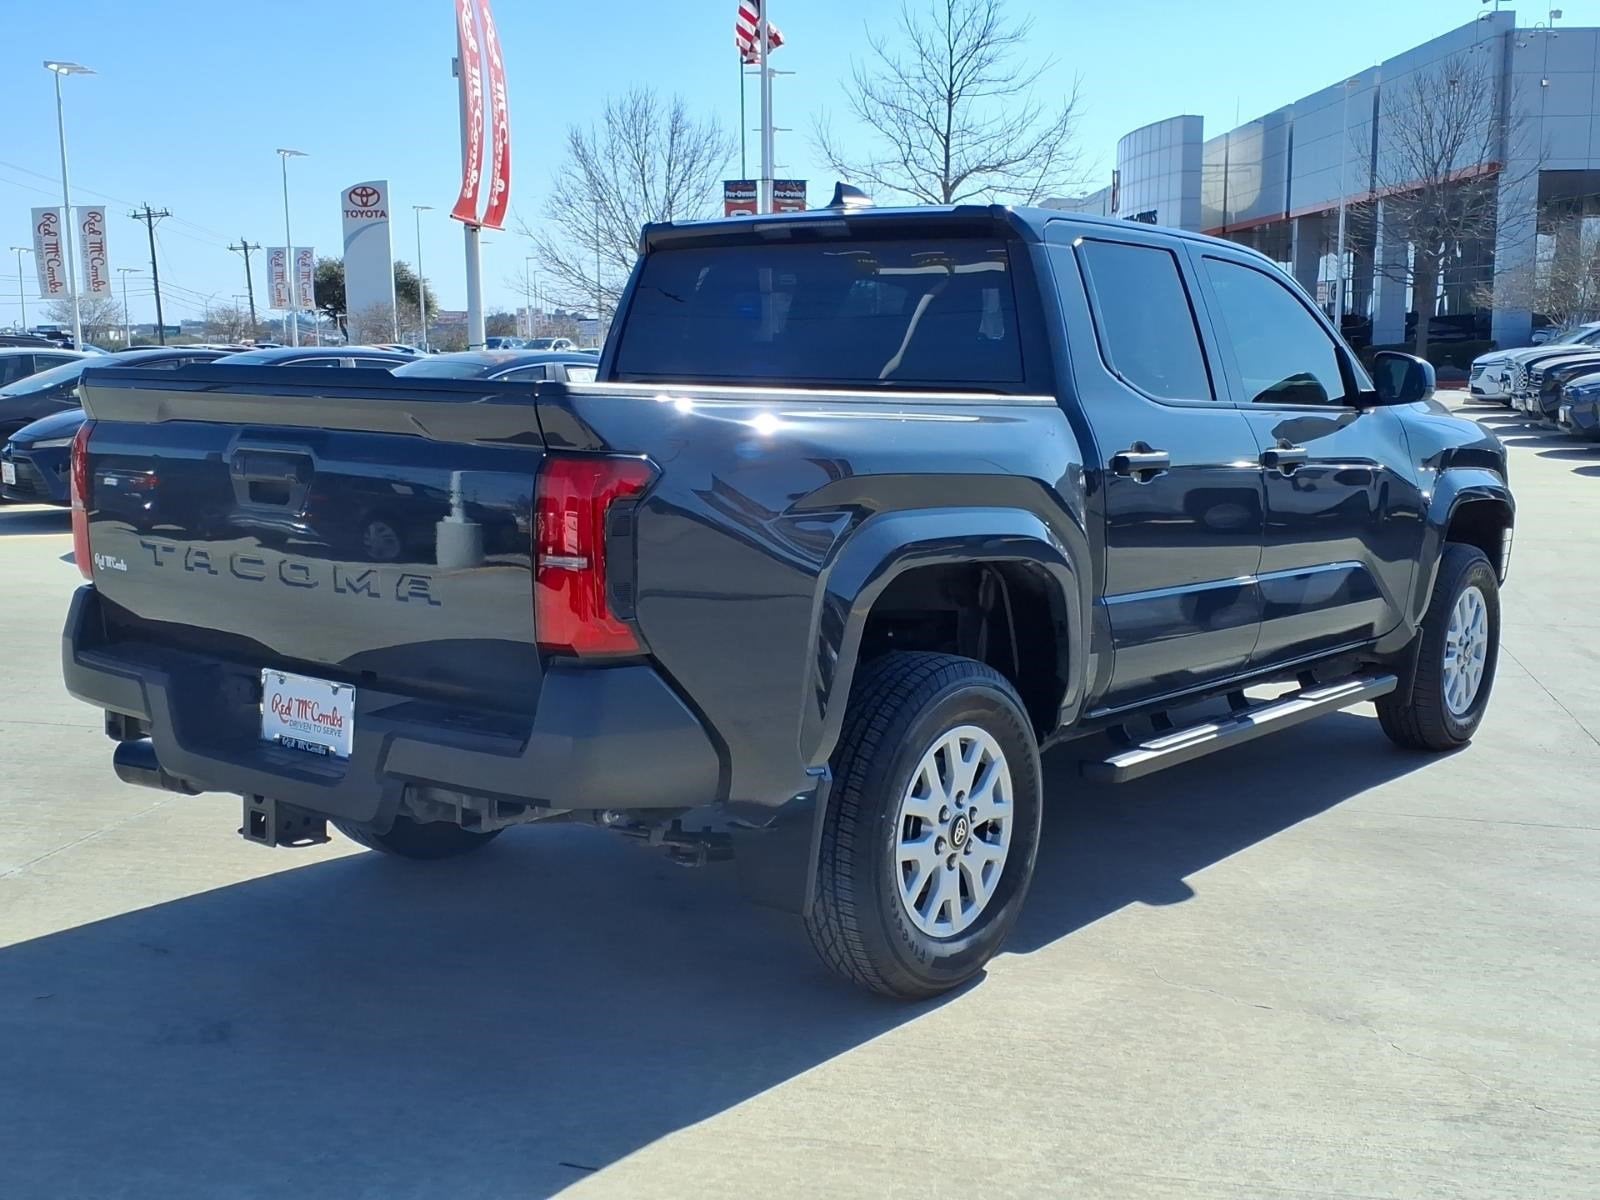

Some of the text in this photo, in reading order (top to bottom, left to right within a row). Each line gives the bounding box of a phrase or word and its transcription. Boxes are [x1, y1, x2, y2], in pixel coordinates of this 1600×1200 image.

[467, 59, 482, 199] McCombs
[493, 77, 508, 206] McCombs
[344, 210, 387, 218] TOYOTA
[725, 190, 757, 198] Pre-Owned
[774, 190, 805, 198] Pre-Owned
[37, 212, 63, 294] Red McCombs
[82, 211, 106, 292] Red McCombs
[140, 539, 442, 607] TACOMA
[271, 692, 342, 728] Red McCombs
[289, 720, 342, 737] DRIVEN TO SERVE
